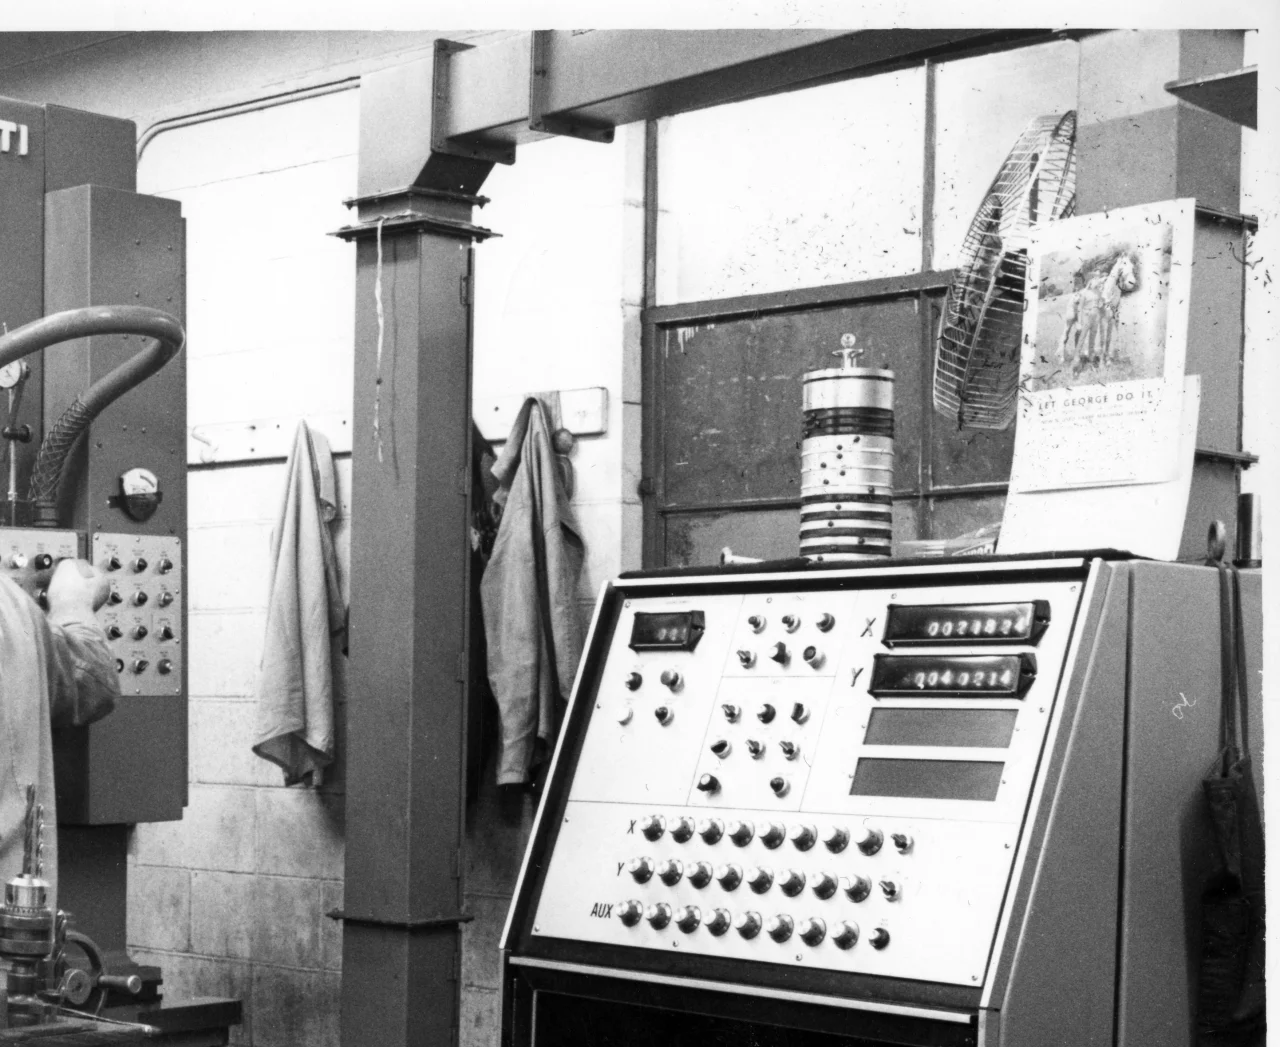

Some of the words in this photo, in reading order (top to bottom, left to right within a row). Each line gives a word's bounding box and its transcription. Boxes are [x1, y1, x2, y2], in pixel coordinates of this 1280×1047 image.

[1038, 400, 1056, 411] LET
[1063, 394, 1109, 408] GEORGE
[1116, 391, 1134, 402] DO
[860, 617, 877, 638] X
[850, 667, 865, 688] Y
[626, 819, 637, 834] X
[616, 862, 625, 877] Y
[589, 902, 614, 919] AUX
